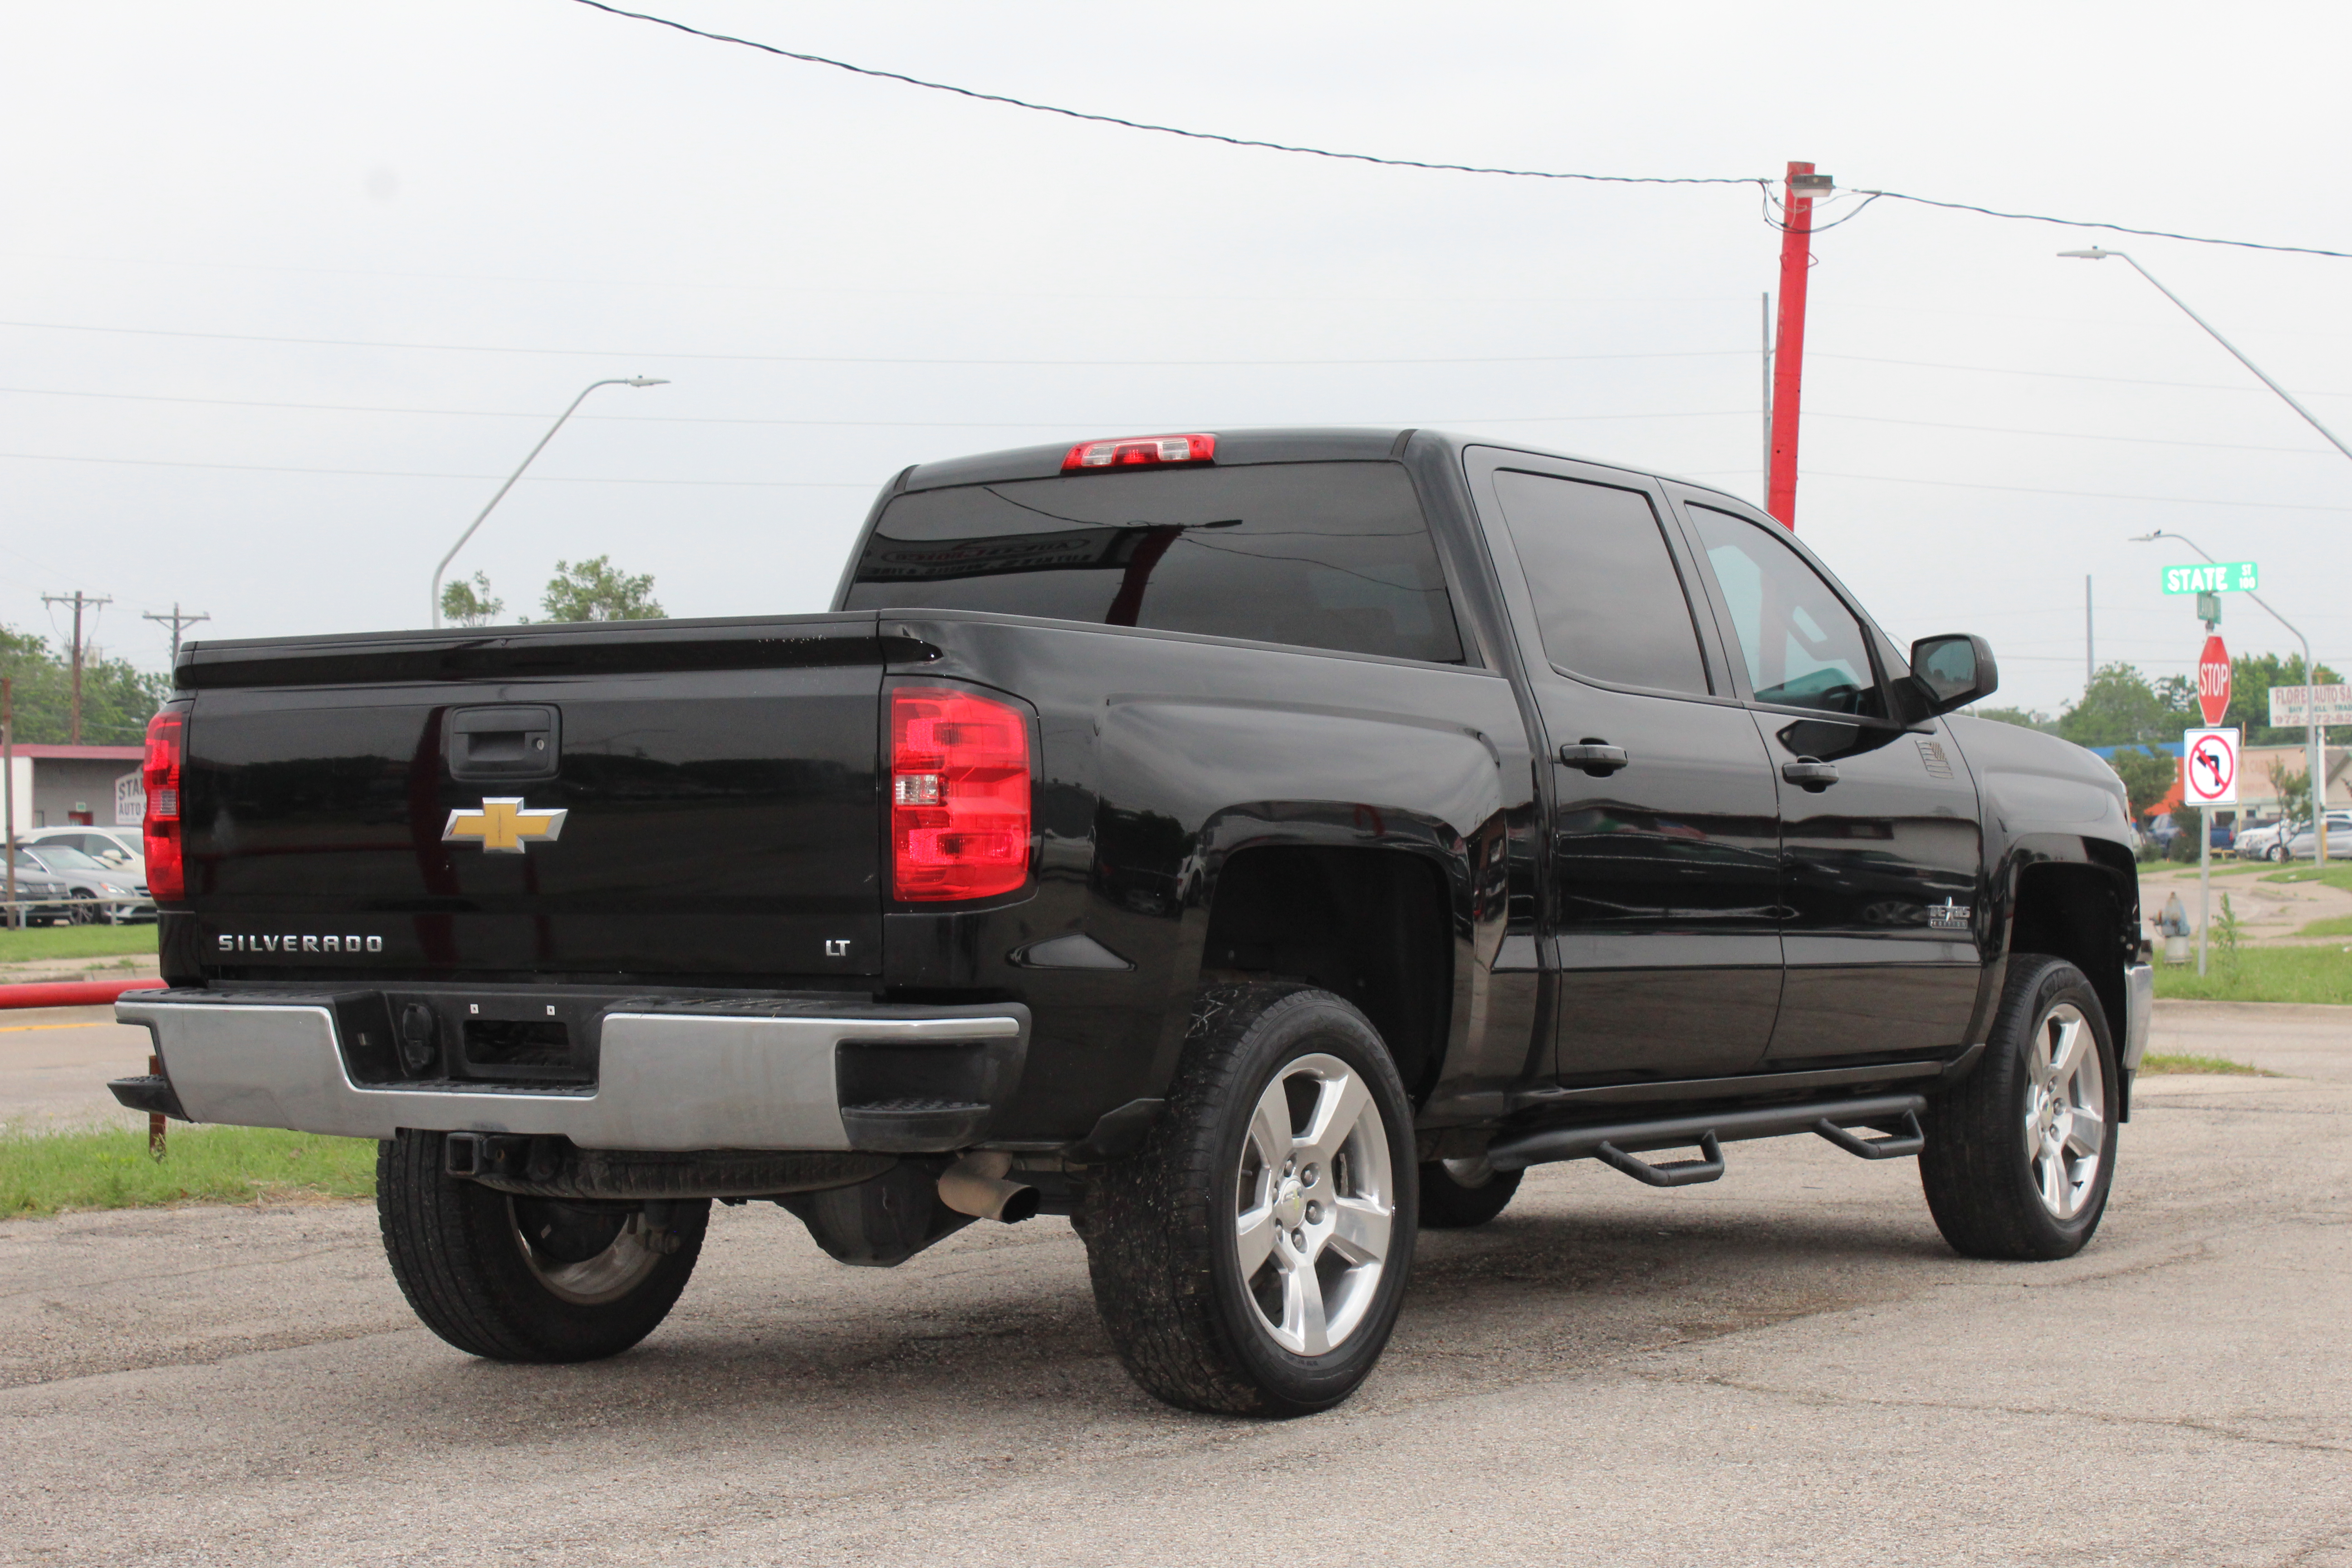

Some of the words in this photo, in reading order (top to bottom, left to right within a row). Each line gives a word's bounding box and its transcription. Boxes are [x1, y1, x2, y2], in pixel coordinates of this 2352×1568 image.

[2167, 567, 2228, 592] STATE
[2242, 564, 2252, 576] ST
[2239, 576, 2255, 589] 100
[2200, 663, 2228, 696] STOP
[2276, 688, 2310, 704] FLORE
[2314, 687, 2337, 703] AUTO
[118, 802, 141, 815] AUTO
[219, 935, 383, 952] SILVERADO
[826, 940, 851, 956] LT
